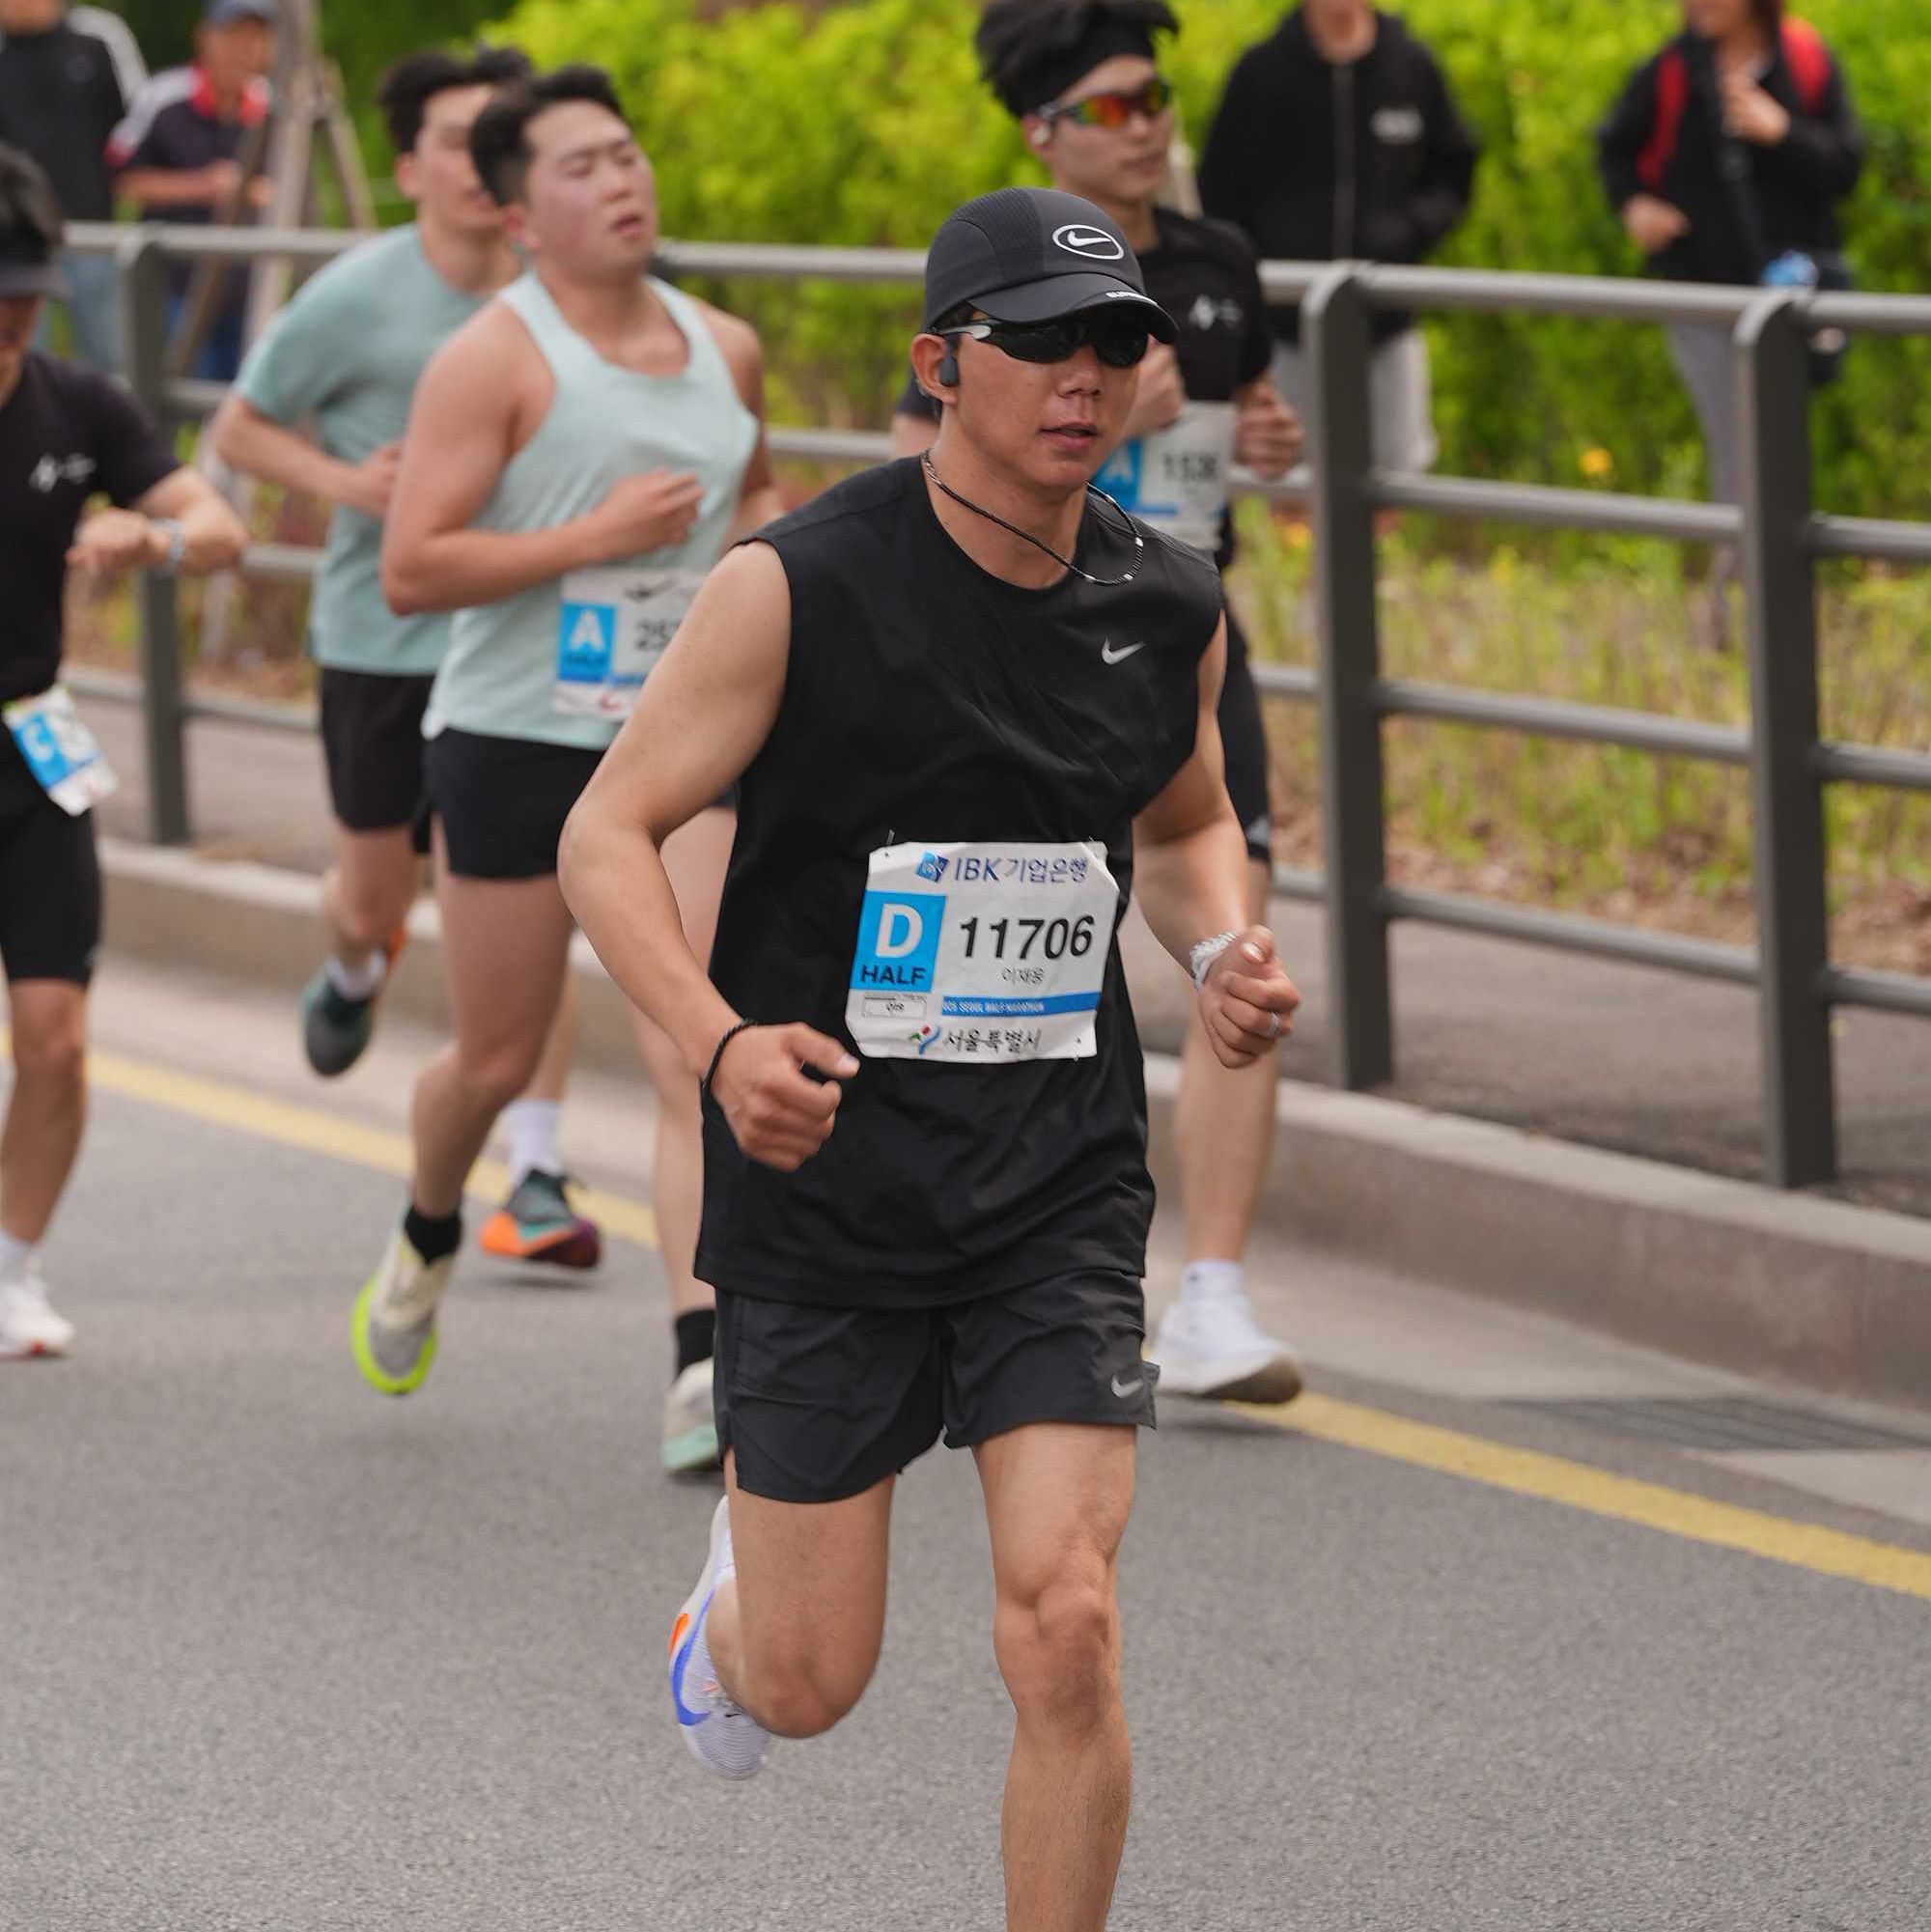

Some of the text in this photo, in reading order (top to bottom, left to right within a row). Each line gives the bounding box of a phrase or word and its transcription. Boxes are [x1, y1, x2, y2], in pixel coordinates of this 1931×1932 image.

[568, 609, 606, 652] A
[875, 903, 924, 958] D
[960, 915, 1096, 961] 11706
[860, 965, 927, 986] HALF
